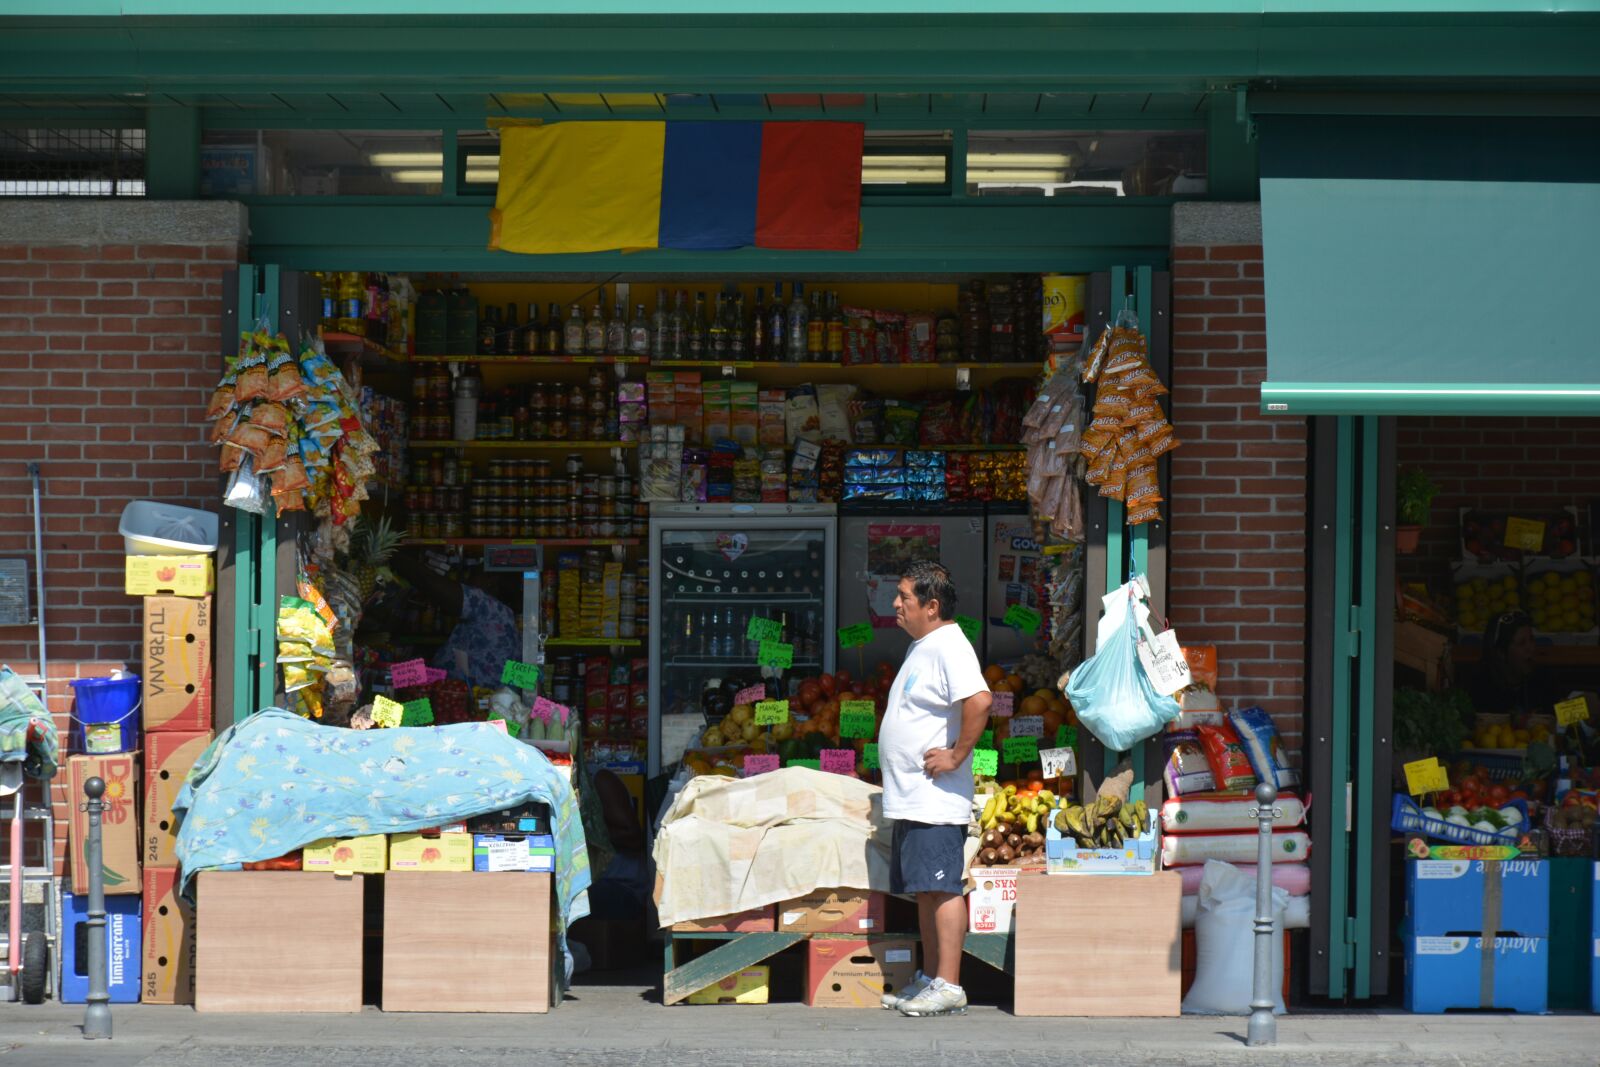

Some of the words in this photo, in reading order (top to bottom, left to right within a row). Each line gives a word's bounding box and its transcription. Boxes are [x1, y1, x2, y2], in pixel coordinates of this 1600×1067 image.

[197, 602, 207, 627] 245
[149, 607, 165, 697] TURBANA
[148, 836, 158, 862] 245
[1476, 860, 1541, 878] Marlee
[995, 879, 1017, 889] NAS
[1002, 889, 1017, 901] CU
[148, 917, 156, 959] Premium
[1475, 937, 1540, 955] Marlee
[147, 971, 157, 997] 245
